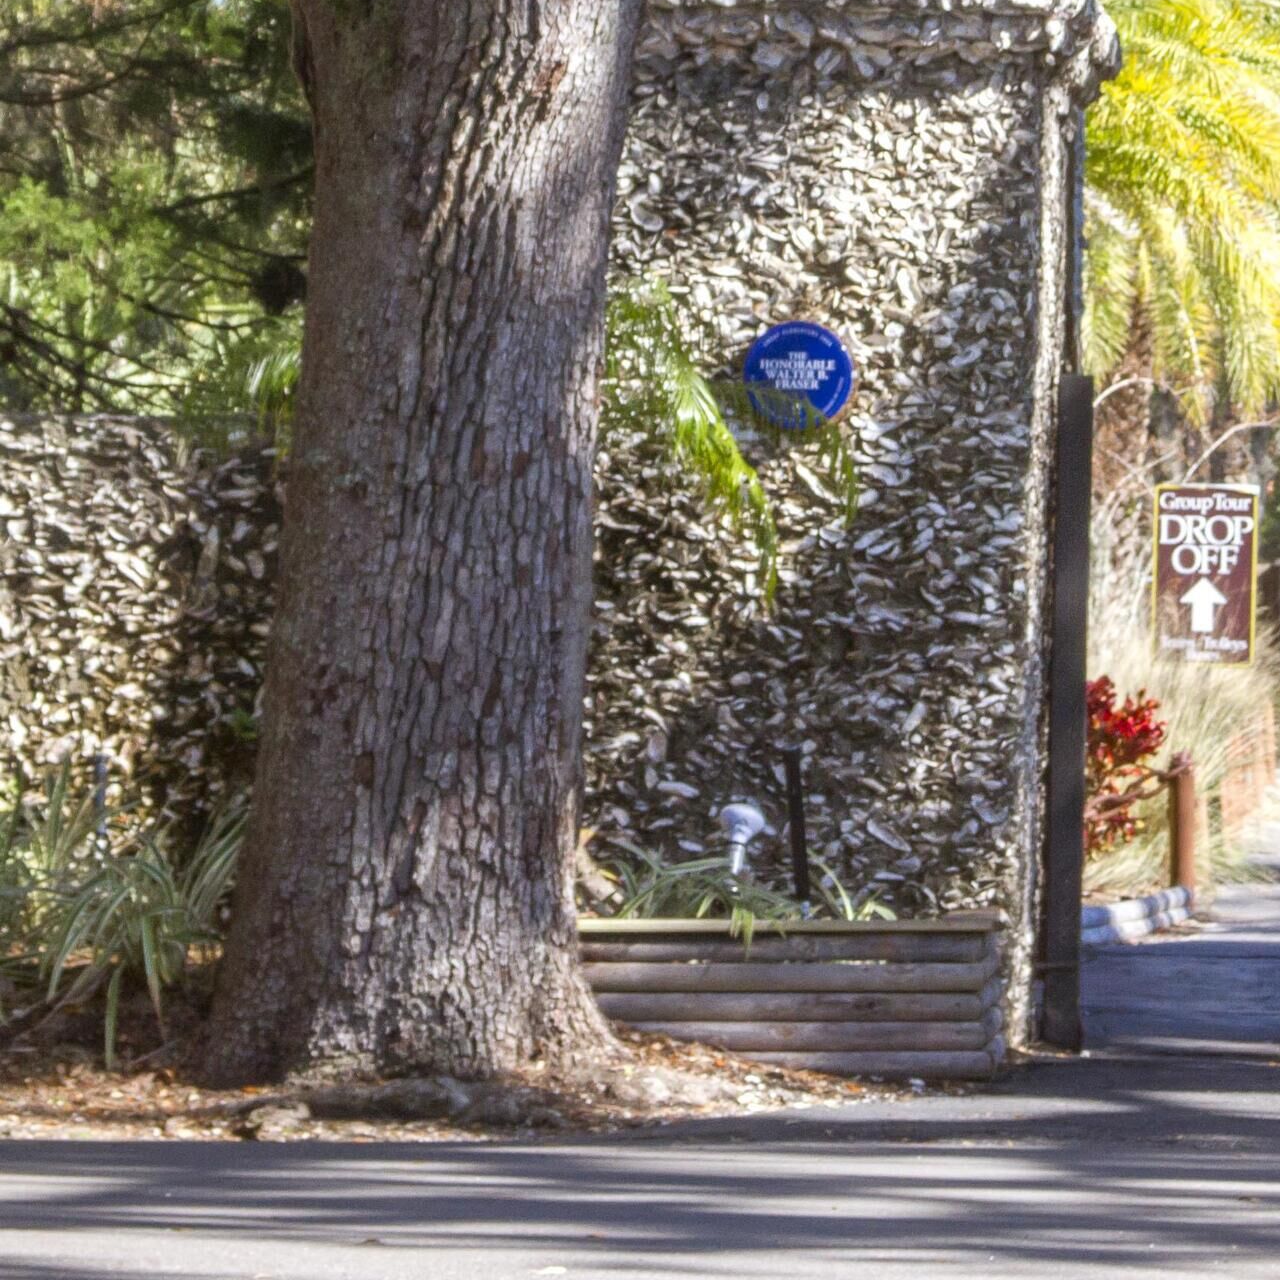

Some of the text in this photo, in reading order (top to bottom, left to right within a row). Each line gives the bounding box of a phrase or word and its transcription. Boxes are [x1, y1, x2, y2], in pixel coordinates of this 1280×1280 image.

[1159, 492, 1252, 515] Group Tour
[1159, 515, 1254, 546] DROP
[1171, 545, 1240, 575] OFF
